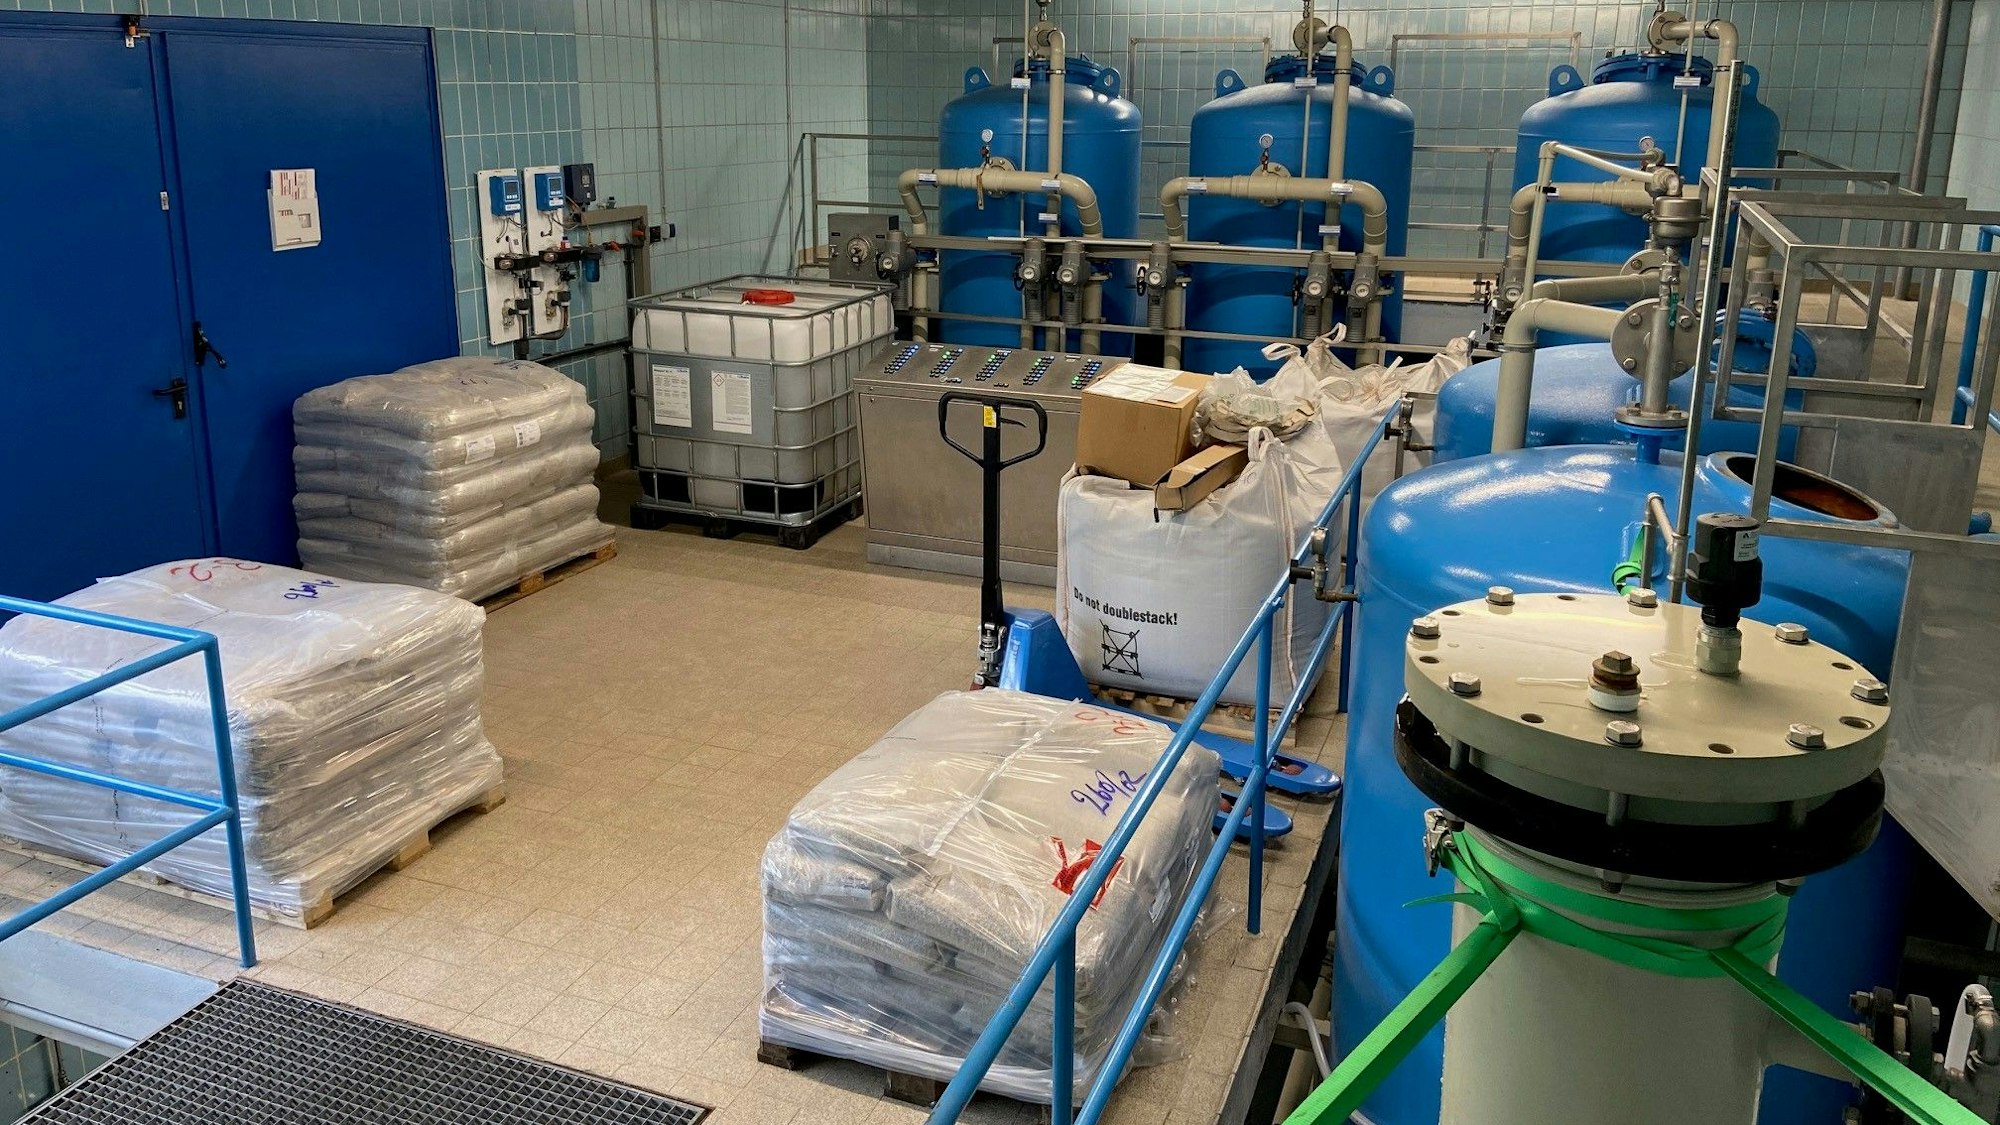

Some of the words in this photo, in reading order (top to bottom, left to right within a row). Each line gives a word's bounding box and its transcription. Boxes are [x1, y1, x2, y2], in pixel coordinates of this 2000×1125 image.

[1074, 586, 1084, 602] Do
[1086, 596, 1101, 612] not
[1103, 602, 1178, 626] doublestack!
